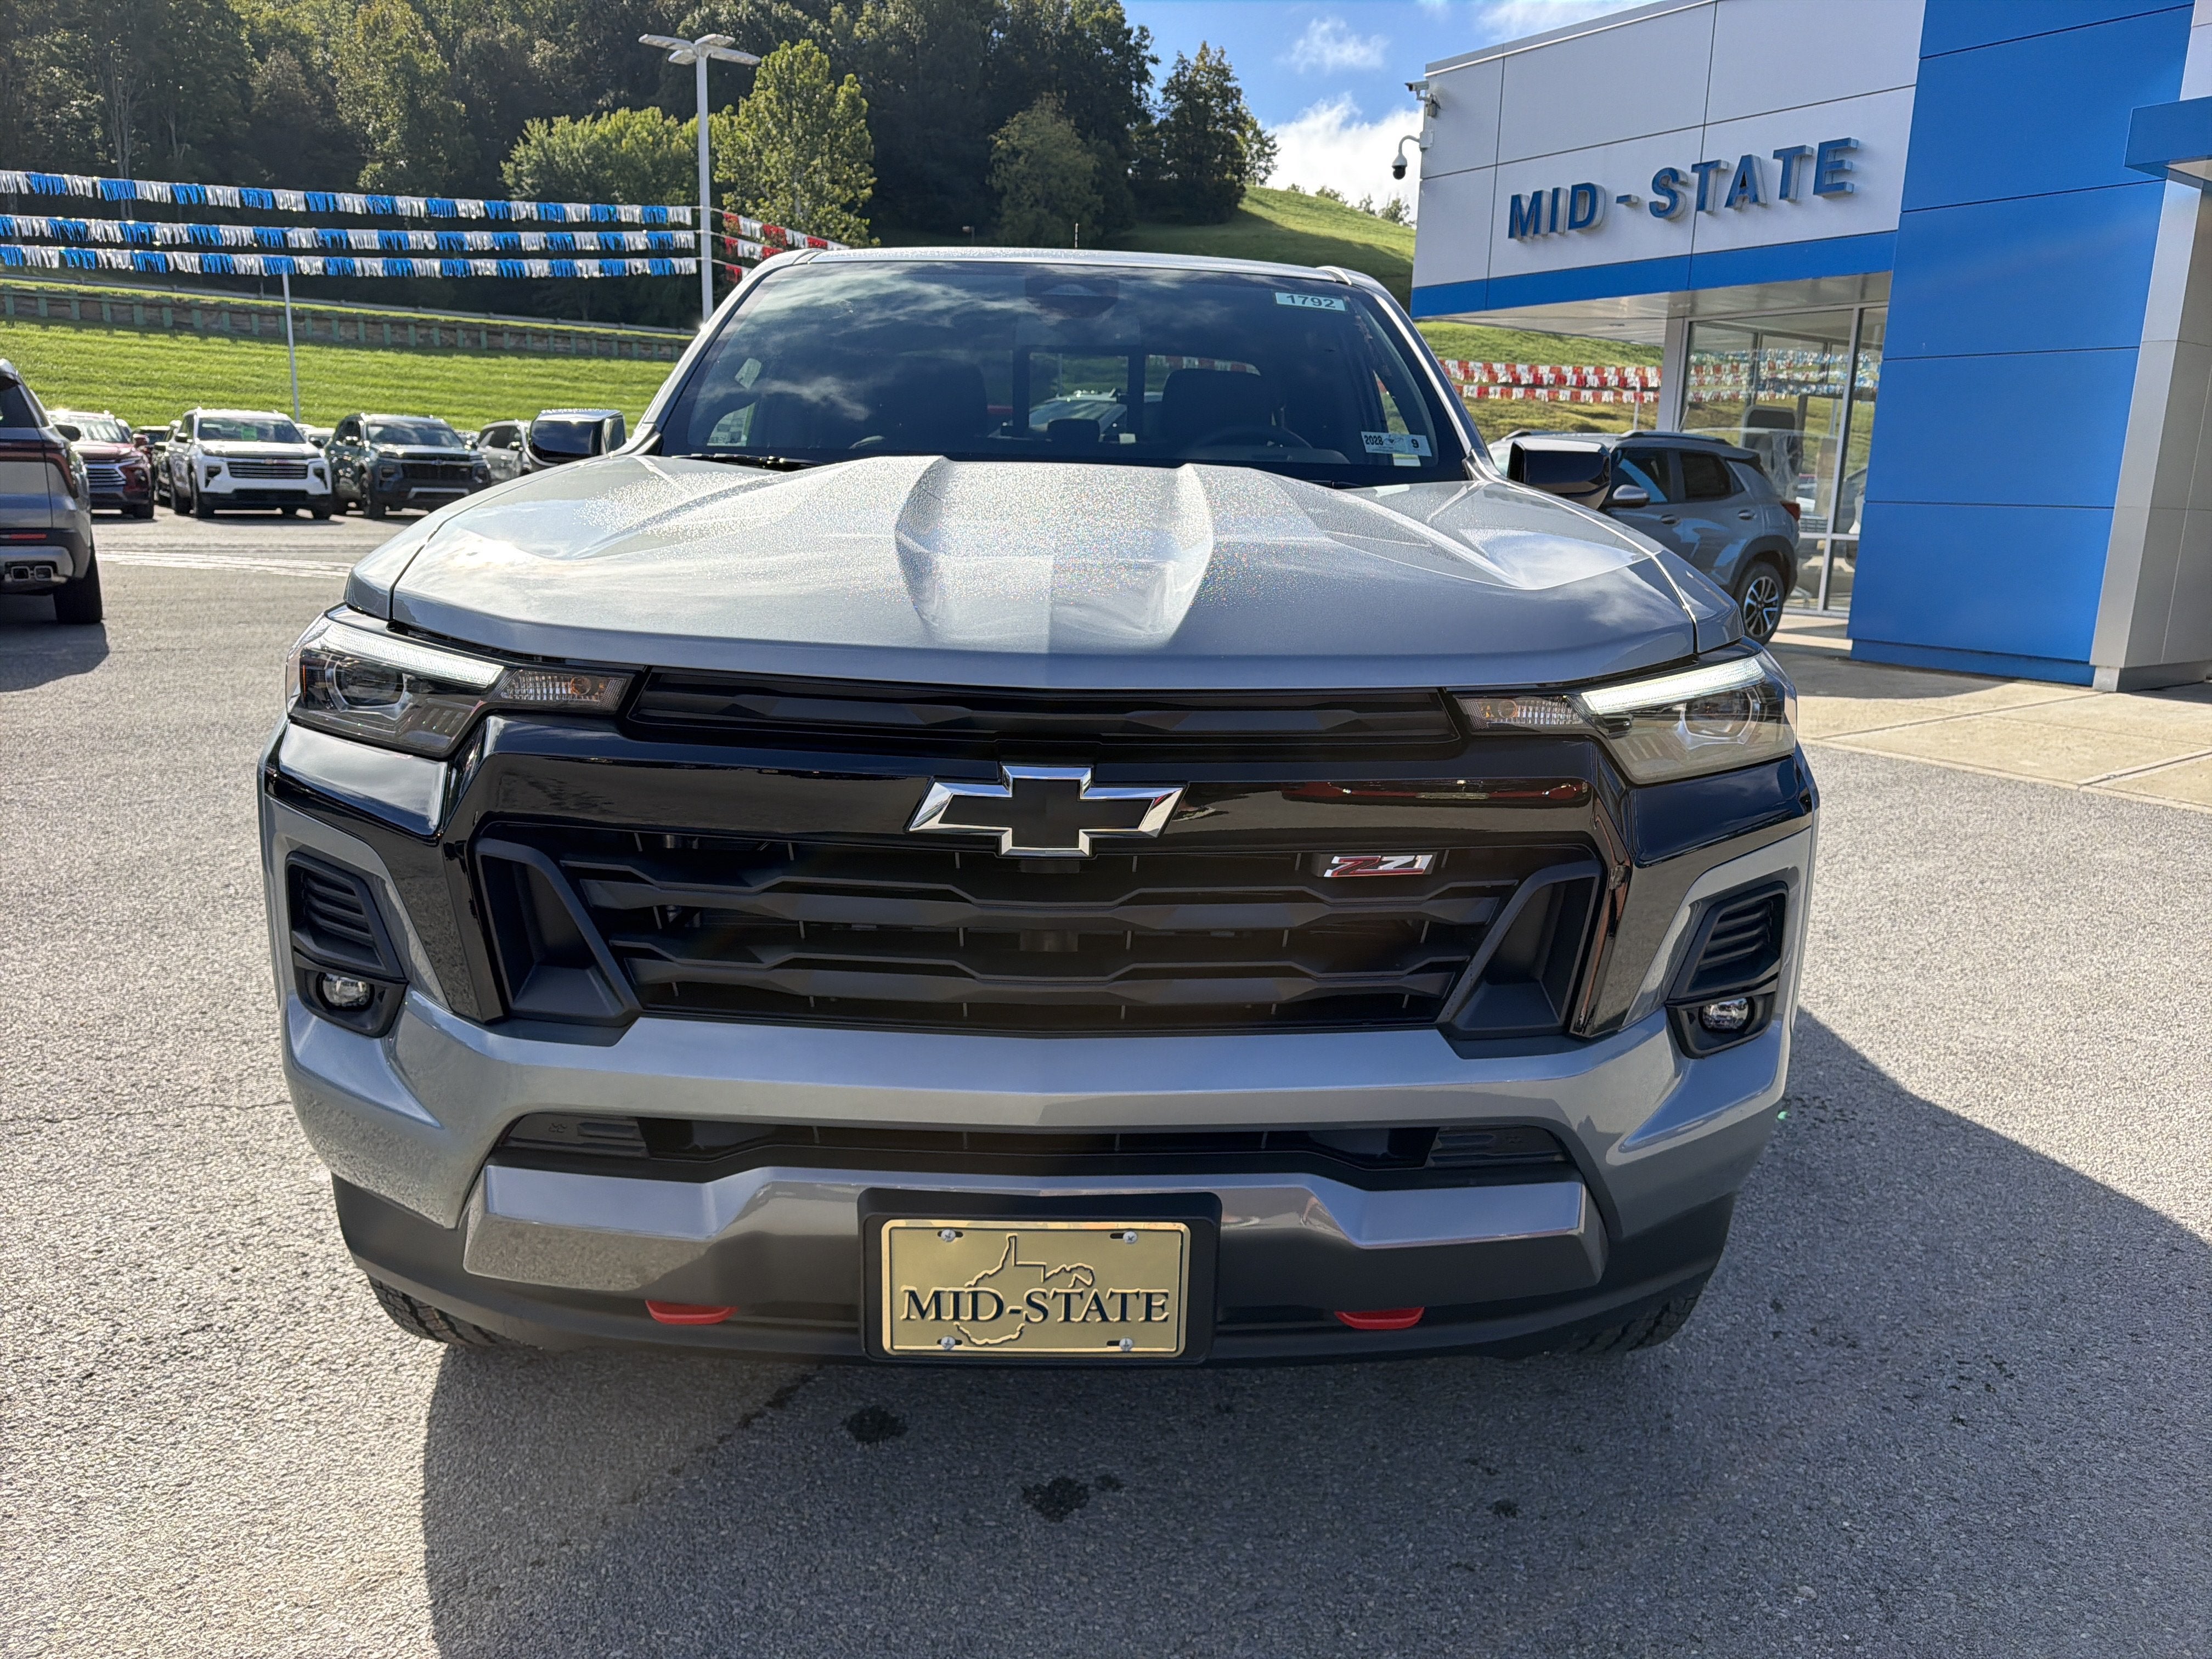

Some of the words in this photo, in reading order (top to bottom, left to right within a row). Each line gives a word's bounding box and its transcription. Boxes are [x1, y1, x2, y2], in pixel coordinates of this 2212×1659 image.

[1286, 295, 1336, 308] 1792
[1411, 439, 1419, 448] 9
[1324, 854, 1433, 877] Z71
[900, 1285, 1170, 1323] MID-STATE
